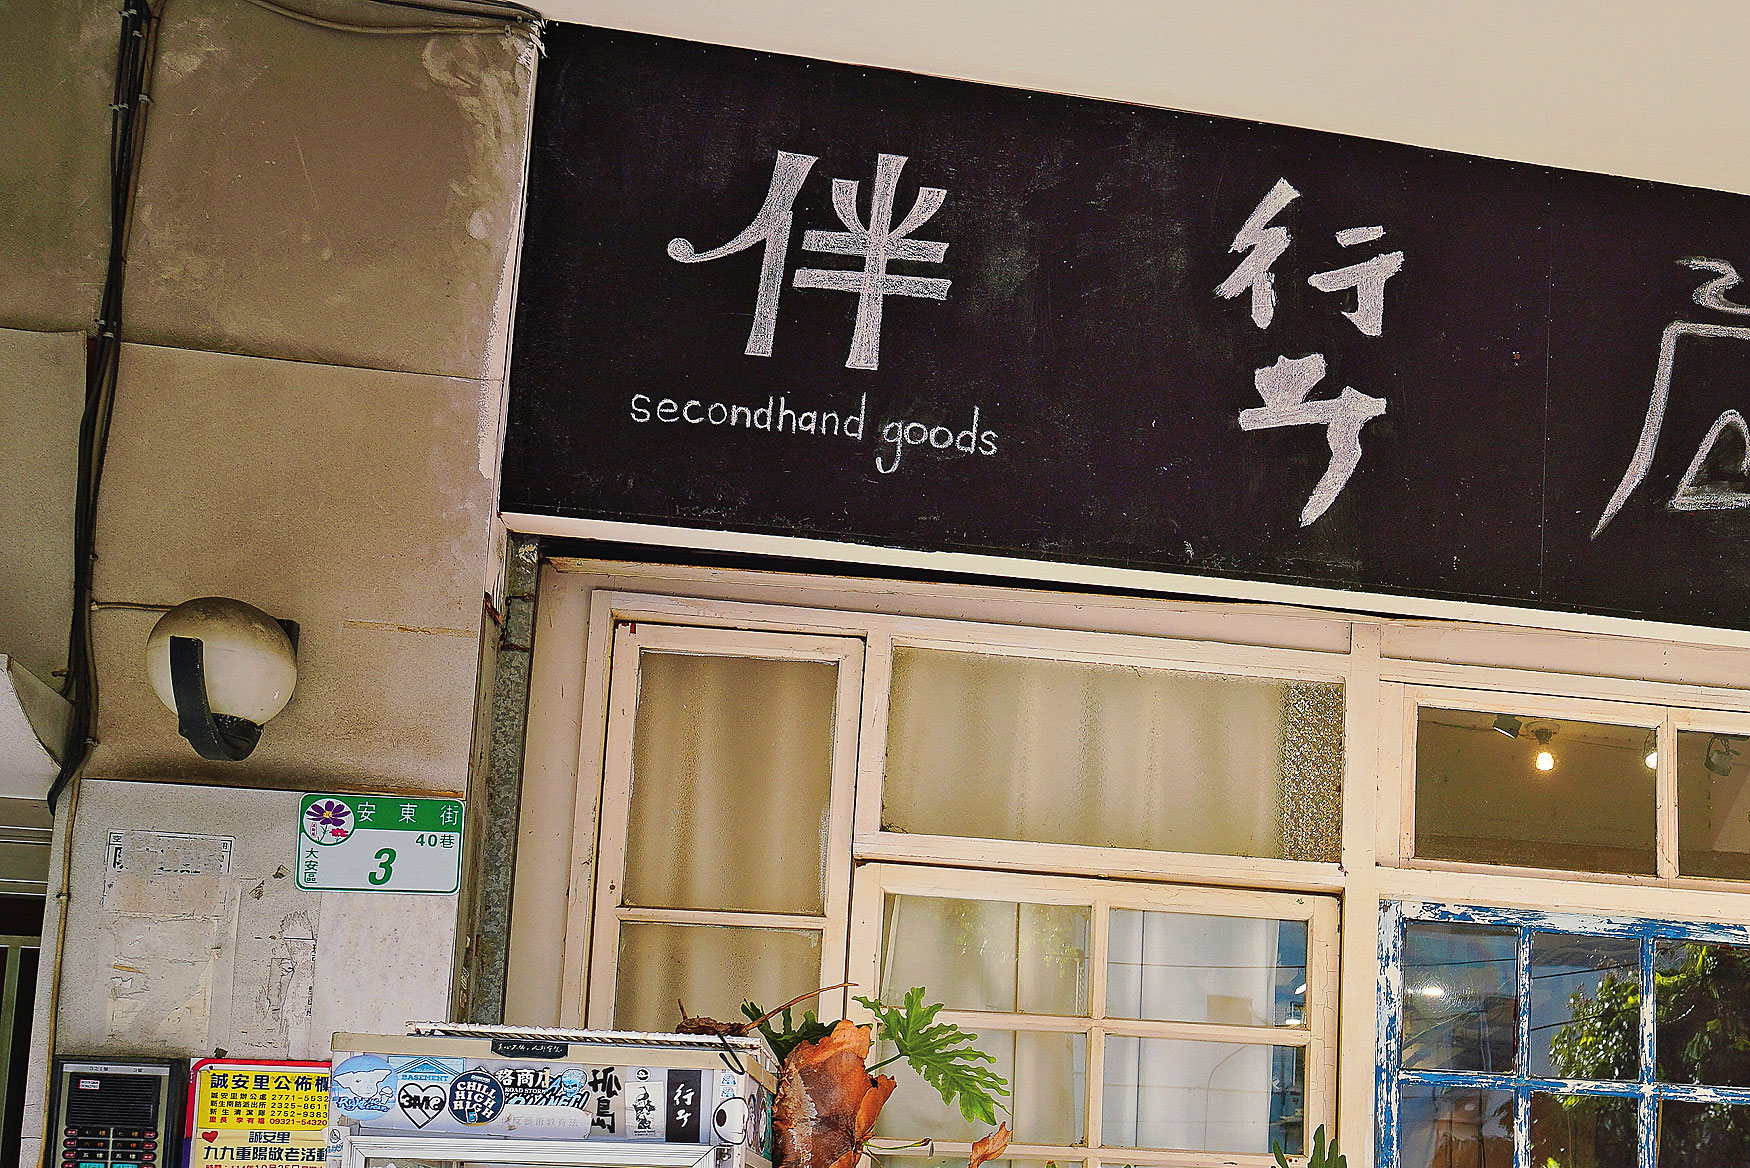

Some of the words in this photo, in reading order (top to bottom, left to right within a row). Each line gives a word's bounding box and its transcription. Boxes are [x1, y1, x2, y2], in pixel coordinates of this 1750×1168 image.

[667, 151, 952, 370] 伴
[630, 391, 867, 441] secondhand
[875, 404, 999, 474] goods
[357, 801, 459, 826] 安東街
[415, 833, 455, 848] 40巷
[303, 847, 319, 884] 大安區
[368, 847, 397, 886] 3
[210, 1073, 329, 1092] 誠安里公佈欄
[401, 1074, 449, 1082] BASEMENT
[271, 1094, 329, 1102] 2771-5532
[454, 1090, 497, 1110] HIGH
[456, 1081, 497, 1100] CHILL
[588, 1066, 622, 1134] 孤島
[270, 1102, 328, 1110] 2325-8611
[270, 1110, 328, 1118] 2752-9383
[452, 1100, 495, 1119] HIGH
[269, 1118, 328, 1126] 09321-54320
[249, 1131, 291, 1144] 誠安里
[203, 1145, 328, 1162] 九九重陽敬老活動
